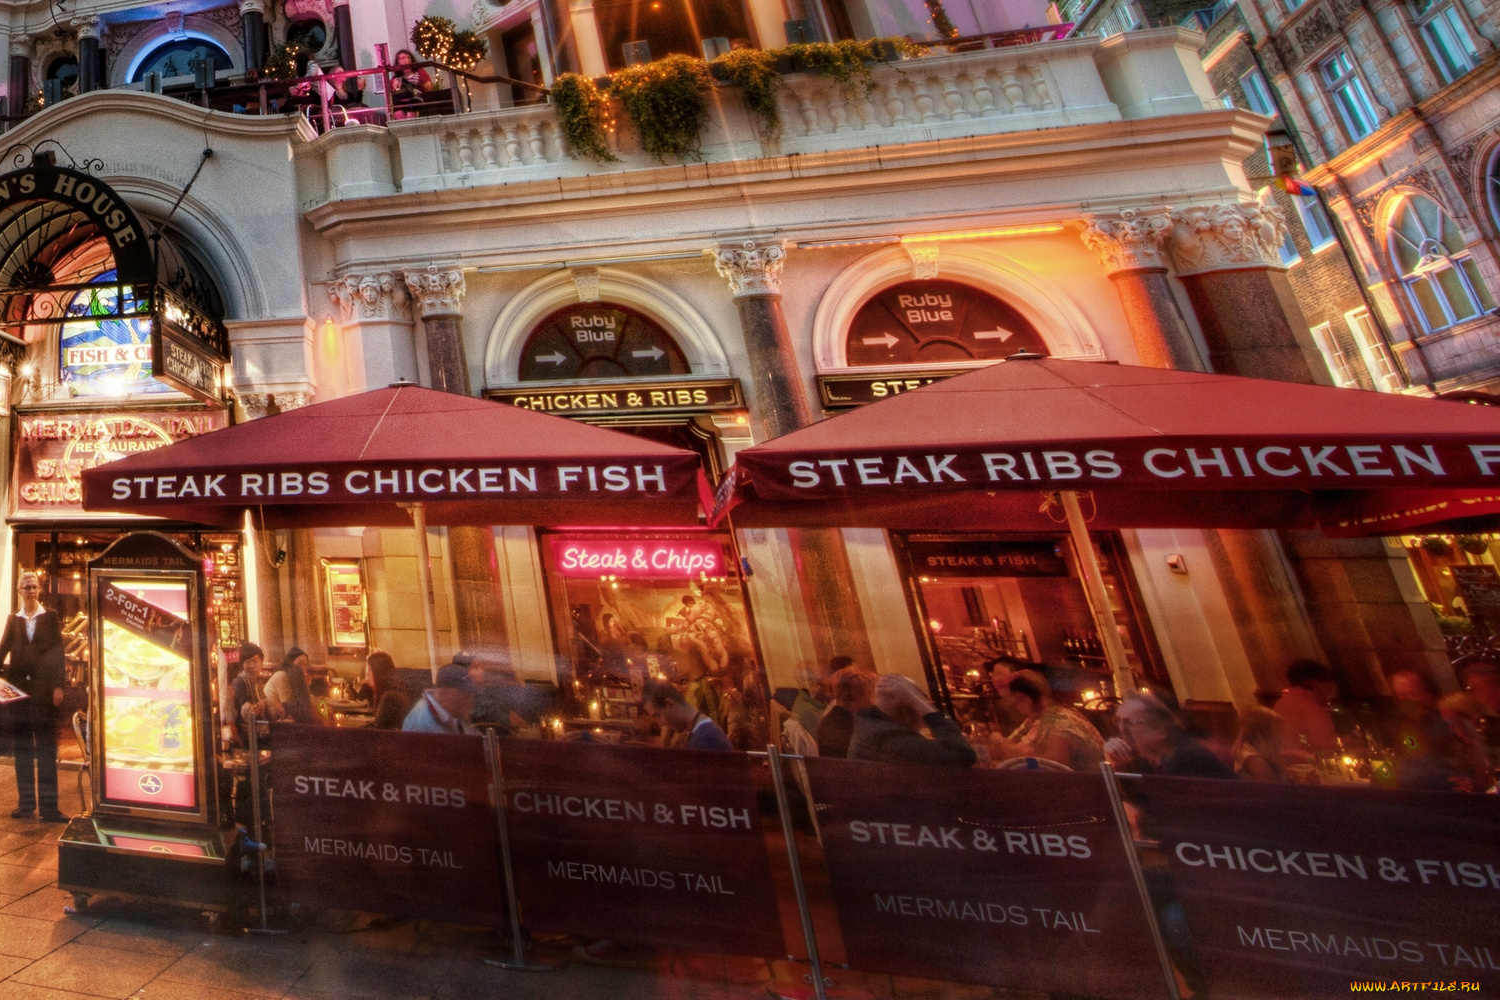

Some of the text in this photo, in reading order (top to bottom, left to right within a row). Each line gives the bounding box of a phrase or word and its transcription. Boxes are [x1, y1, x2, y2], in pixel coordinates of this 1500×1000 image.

[53, 173, 138, 249] HOUSE
[898, 293, 954, 309] Ruby
[571, 315, 616, 330] Ruby
[906, 310, 954, 324] Blue
[576, 330, 616, 343] Blue
[70, 349, 108, 364] FISH
[114, 347, 129, 361] &
[171, 343, 192, 366] STEAK
[513, 389, 709, 412] CHICKEN & RIBS
[871, 380, 933, 398] STE
[21, 416, 219, 439] MERMAIDS TAIL
[75, 440, 165, 453] RESTAURANT
[788, 454, 967, 489] STEAK
[980, 450, 1123, 482] RIBS
[1143, 444, 1448, 479] CHICKEN
[20, 481, 83, 502] CHIC
[112, 465, 667, 500] STEAK RIBS CHICKEN FISH
[103, 557, 187, 566] MERMAIDS TAIL
[562, 548, 716, 575] Steak & Chips
[927, 555, 1037, 567] STEAK & FISH
[105, 588, 149, 619] 2-For-1
[294, 775, 467, 809] STEAK & RIBS
[512, 791, 753, 830] CHICKEN & FISH
[850, 820, 1092, 859] STEAK & RIBS
[304, 835, 464, 871] MERMAIDS TAIL
[1175, 842, 1370, 880] CHICKEN
[1377, 856, 1411, 883] &
[547, 859, 735, 896] MERMAIDS TAIL
[874, 892, 1101, 934] MERMAIDS TAIL
[1236, 924, 1500, 971] MERMAIDS TAIL
